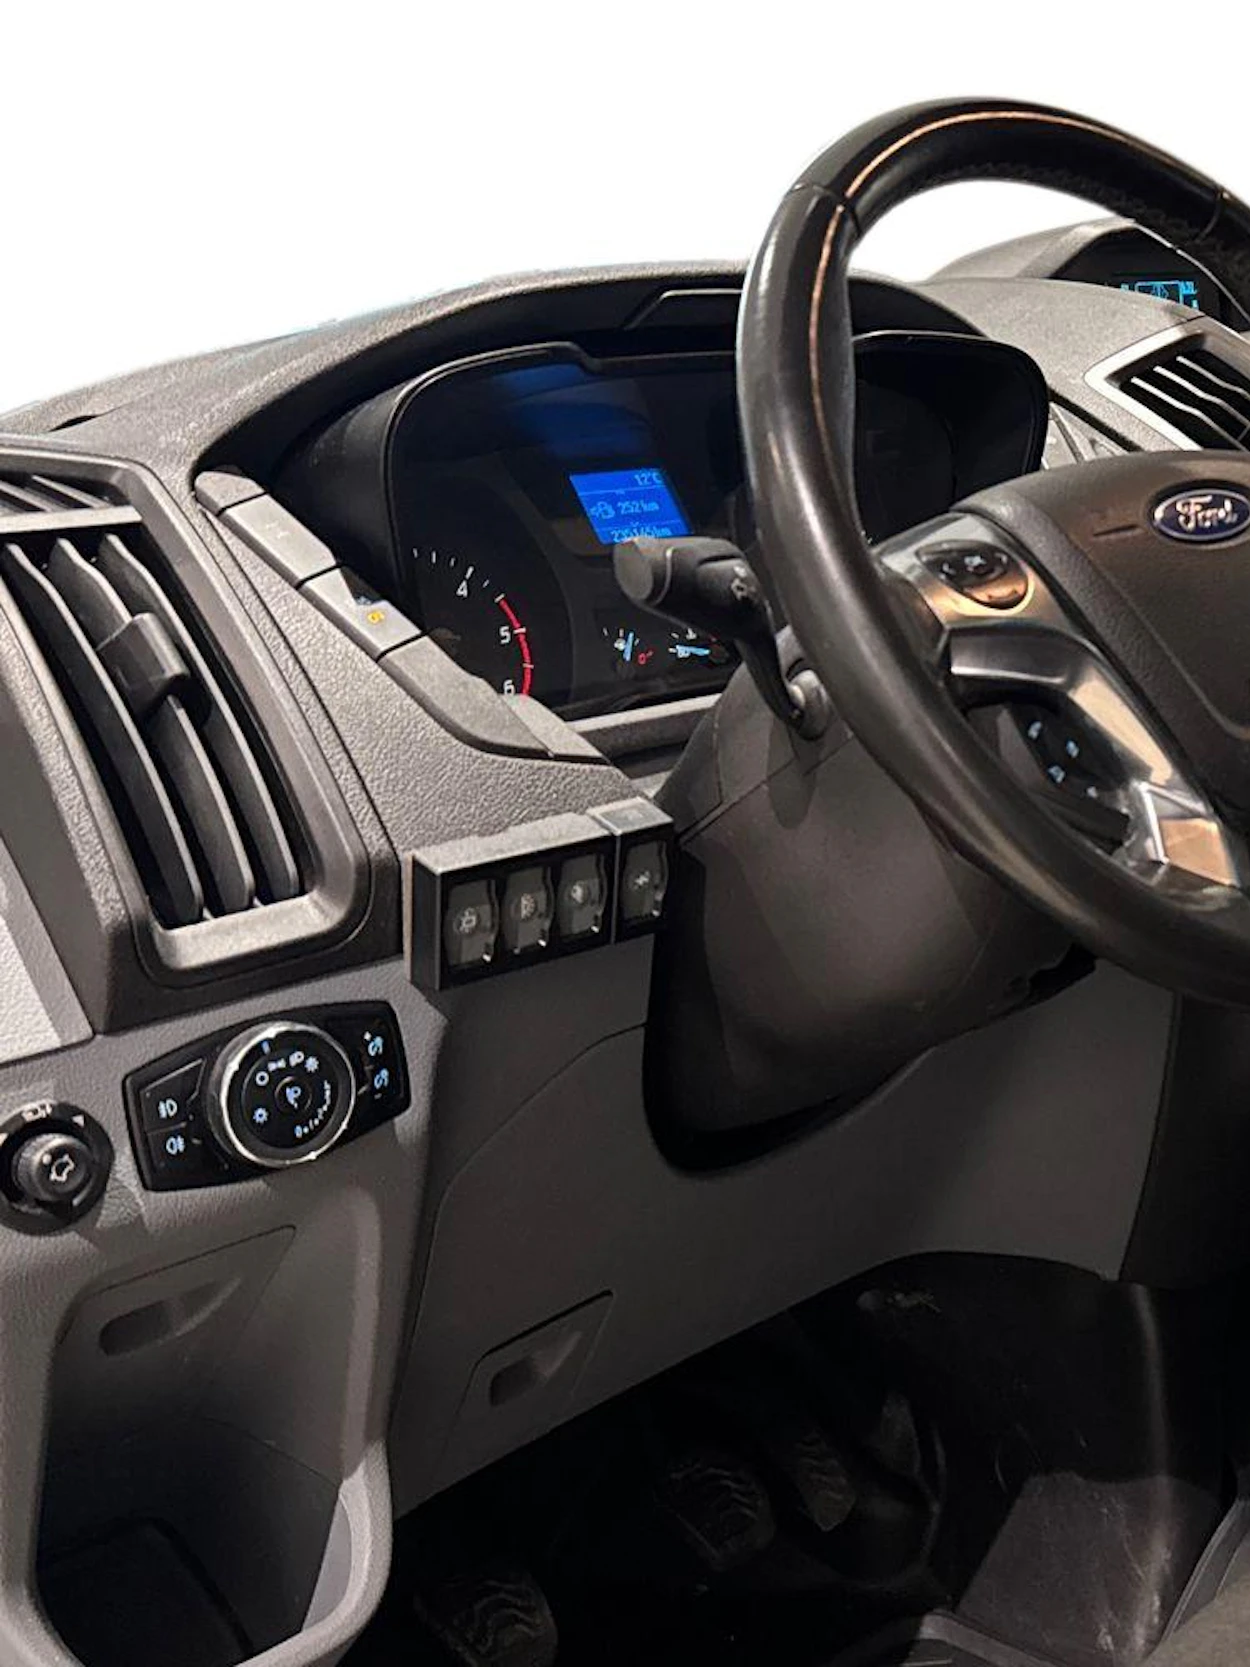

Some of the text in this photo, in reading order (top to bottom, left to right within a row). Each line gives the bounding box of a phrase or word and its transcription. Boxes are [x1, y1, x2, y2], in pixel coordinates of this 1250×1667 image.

[1175, 494, 1238, 532] Ford
[457, 580, 468, 597] 4
[499, 625, 511, 644] 5
[502, 679, 515, 695] 6
